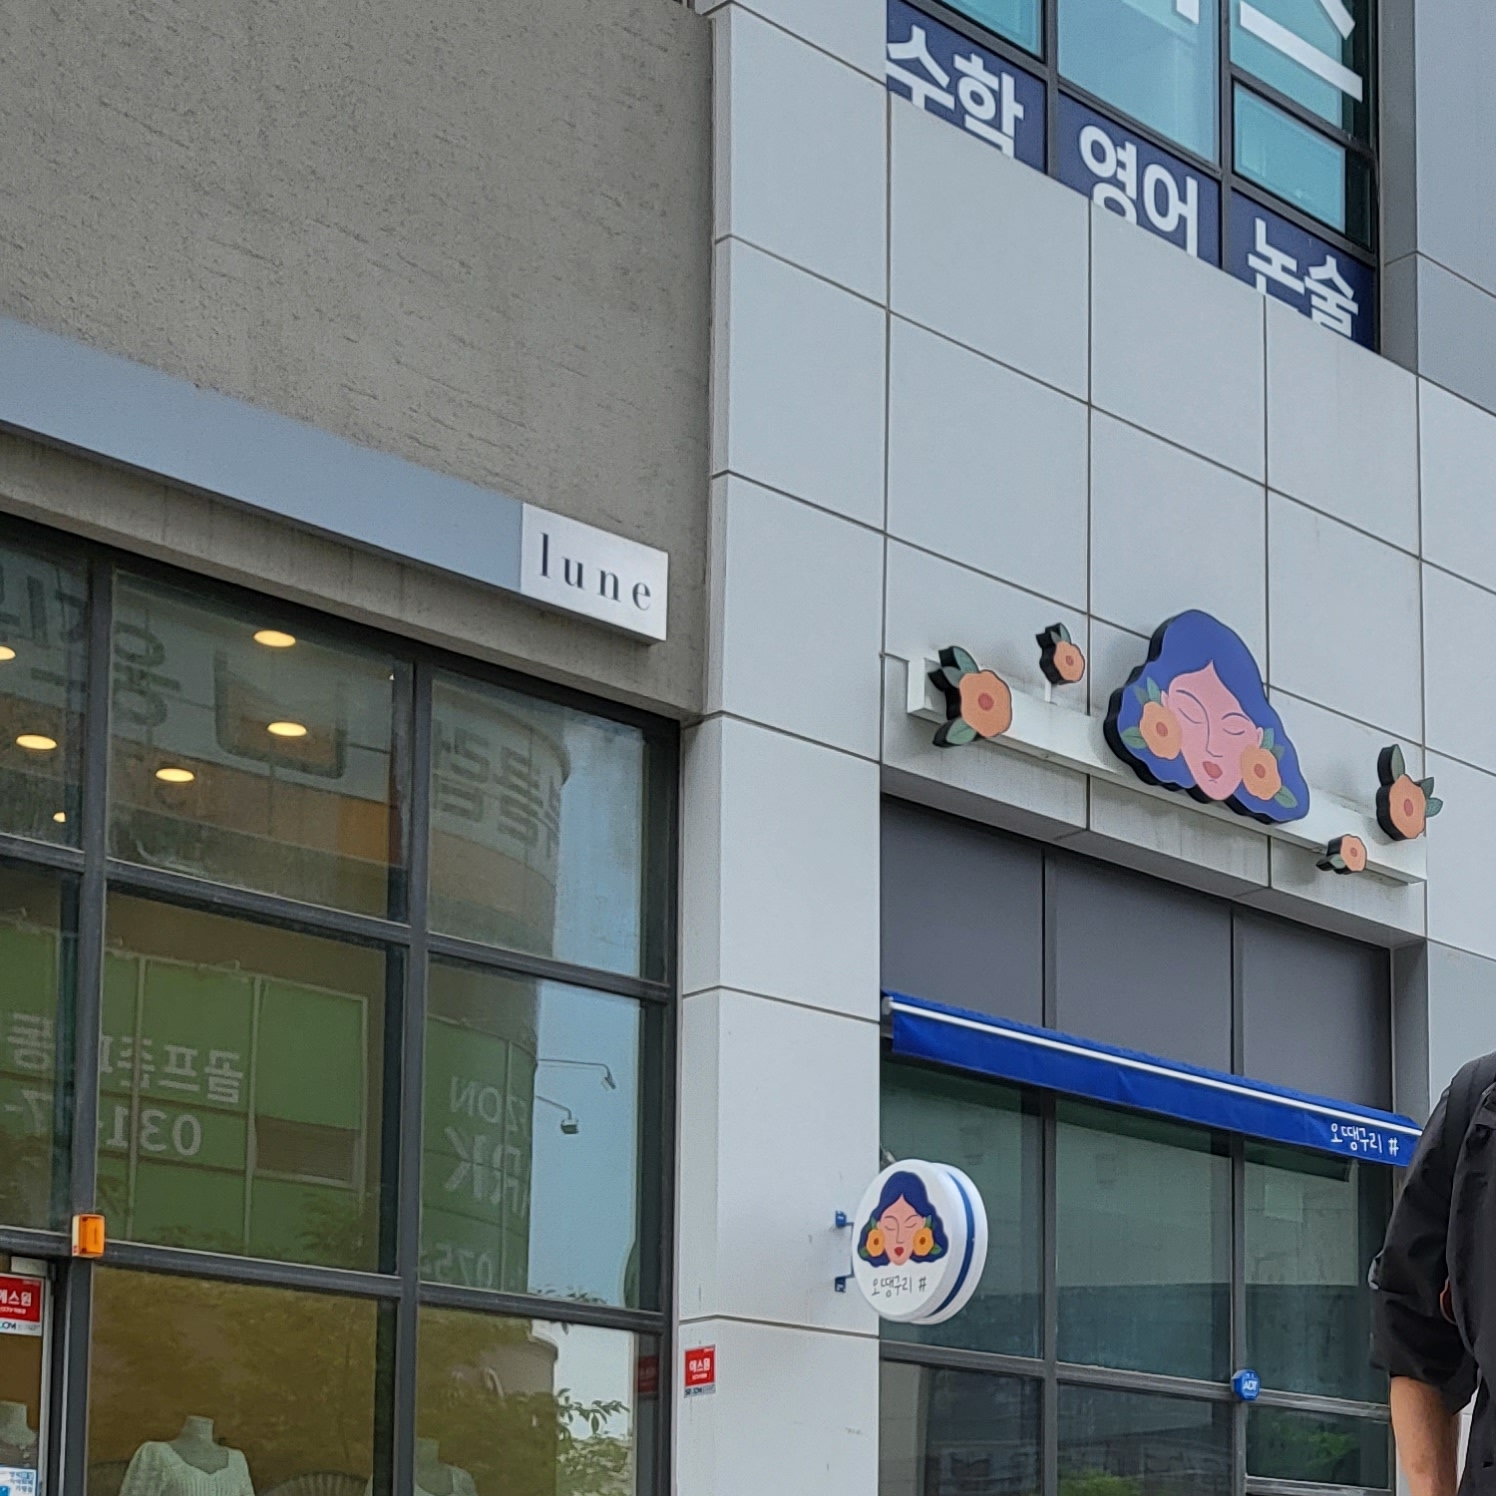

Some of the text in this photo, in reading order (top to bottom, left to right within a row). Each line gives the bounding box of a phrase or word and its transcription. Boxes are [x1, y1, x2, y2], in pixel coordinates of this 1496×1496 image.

[886, 24, 1024, 160] 수학
[1079, 124, 1199, 259] 영어
[1247, 217, 1360, 339] 논술
[538, 531, 653, 612] lune
[1330, 1122, 1383, 1154] 오땡구리
[871, 1275, 912, 1298] 오땡구리
